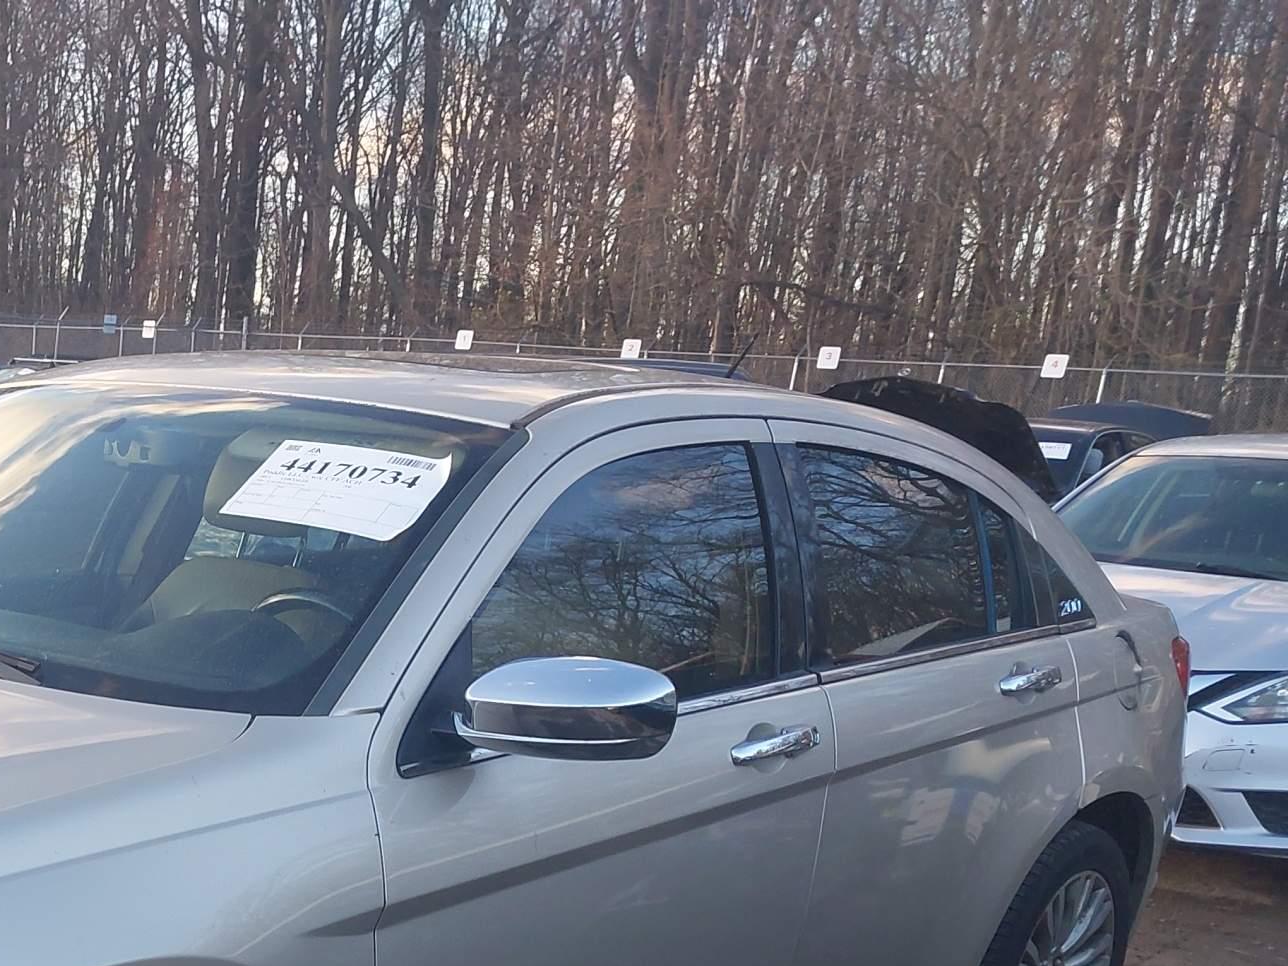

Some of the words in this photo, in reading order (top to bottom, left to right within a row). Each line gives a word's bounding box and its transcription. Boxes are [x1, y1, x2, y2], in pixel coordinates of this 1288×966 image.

[825, 352, 833, 360] 3
[1051, 360, 1059, 369] 4
[280, 457, 422, 489] 44170734
[1059, 598, 1082, 617] 200
